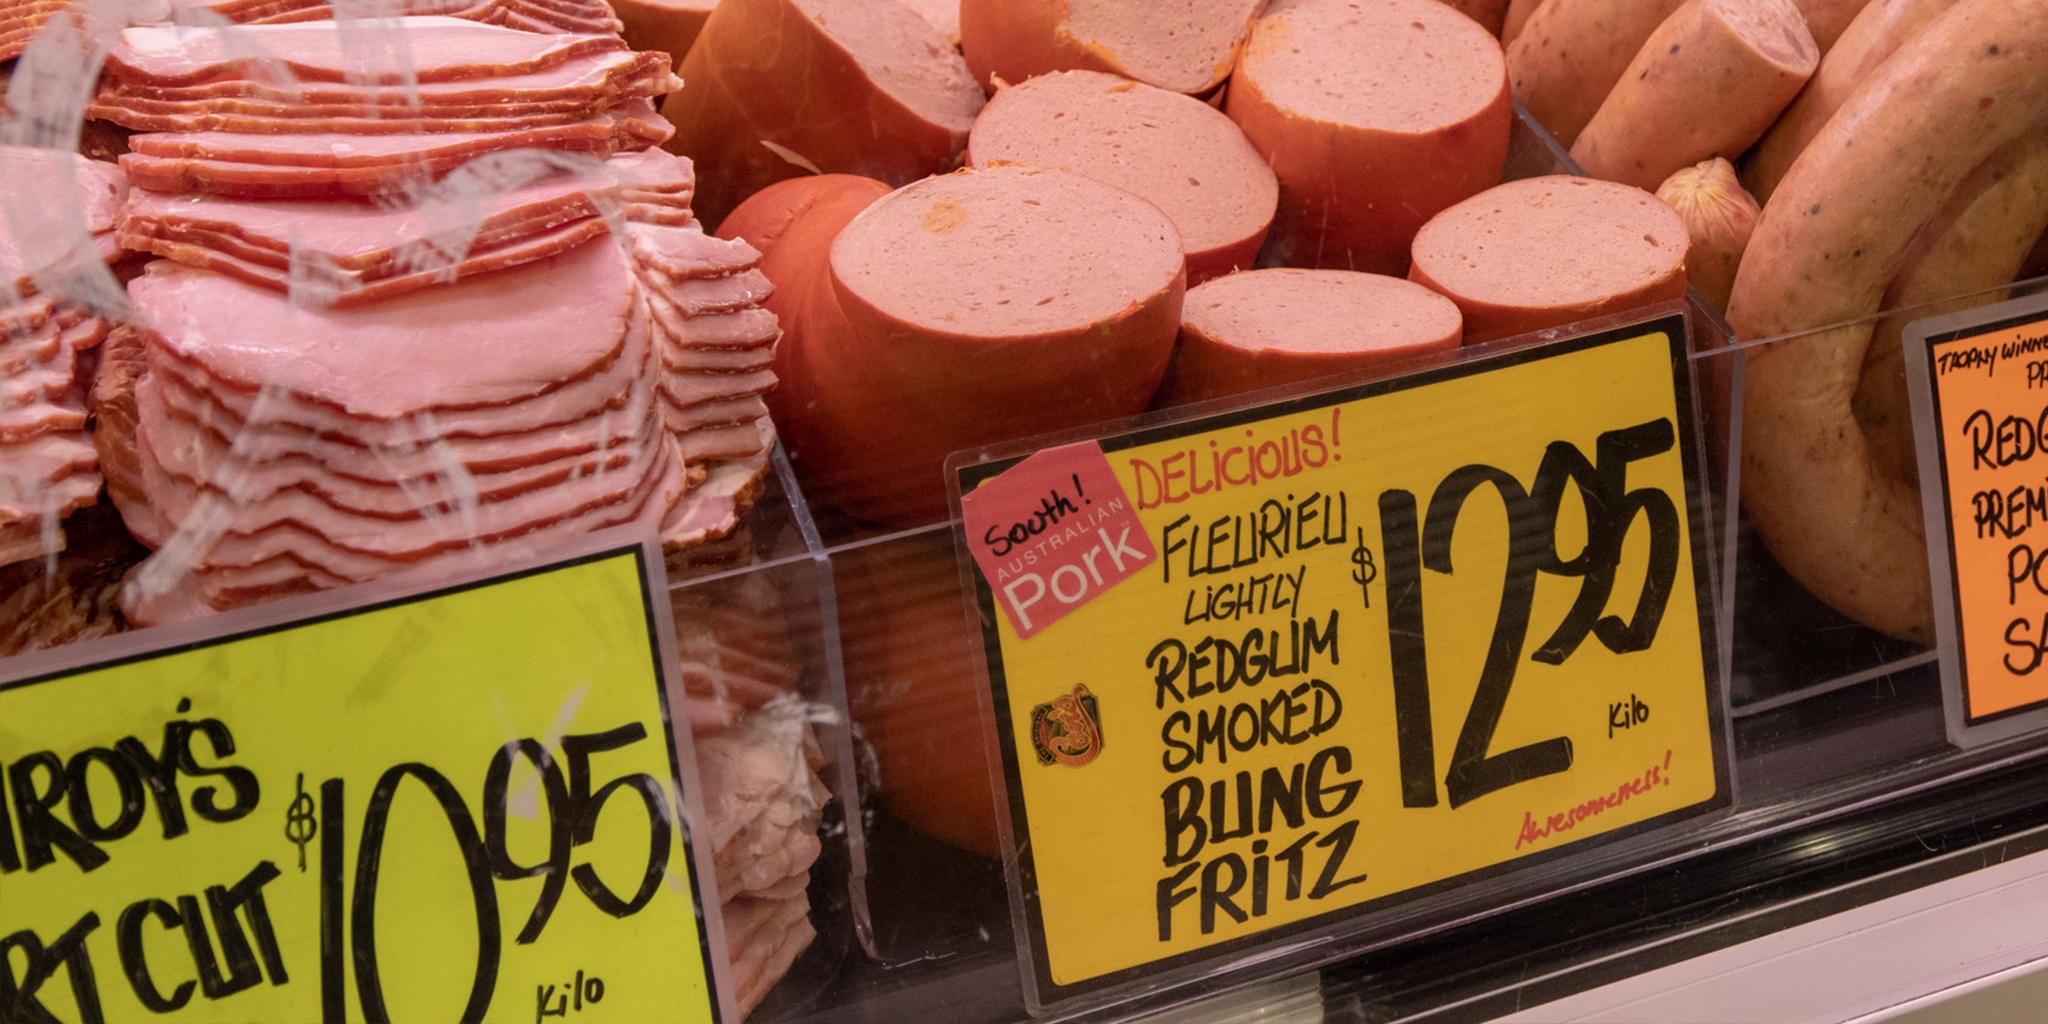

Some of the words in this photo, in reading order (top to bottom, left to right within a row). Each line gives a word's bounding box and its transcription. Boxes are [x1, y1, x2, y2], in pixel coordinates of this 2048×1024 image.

[984, 473, 1091, 557] South!
[998, 497, 1124, 582] AUSTRALIAN
[1972, 476, 2048, 540] PREM
[1003, 524, 1147, 631] Pork
[1146, 609, 1339, 710] REDGUM
[1162, 679, 1342, 774] SMOKED
[1609, 694, 1650, 739] Kilo
[0, 696, 261, 874] ROY'S
[1161, 746, 1363, 868] BUNG
[116, 860, 289, 1014] CUT
